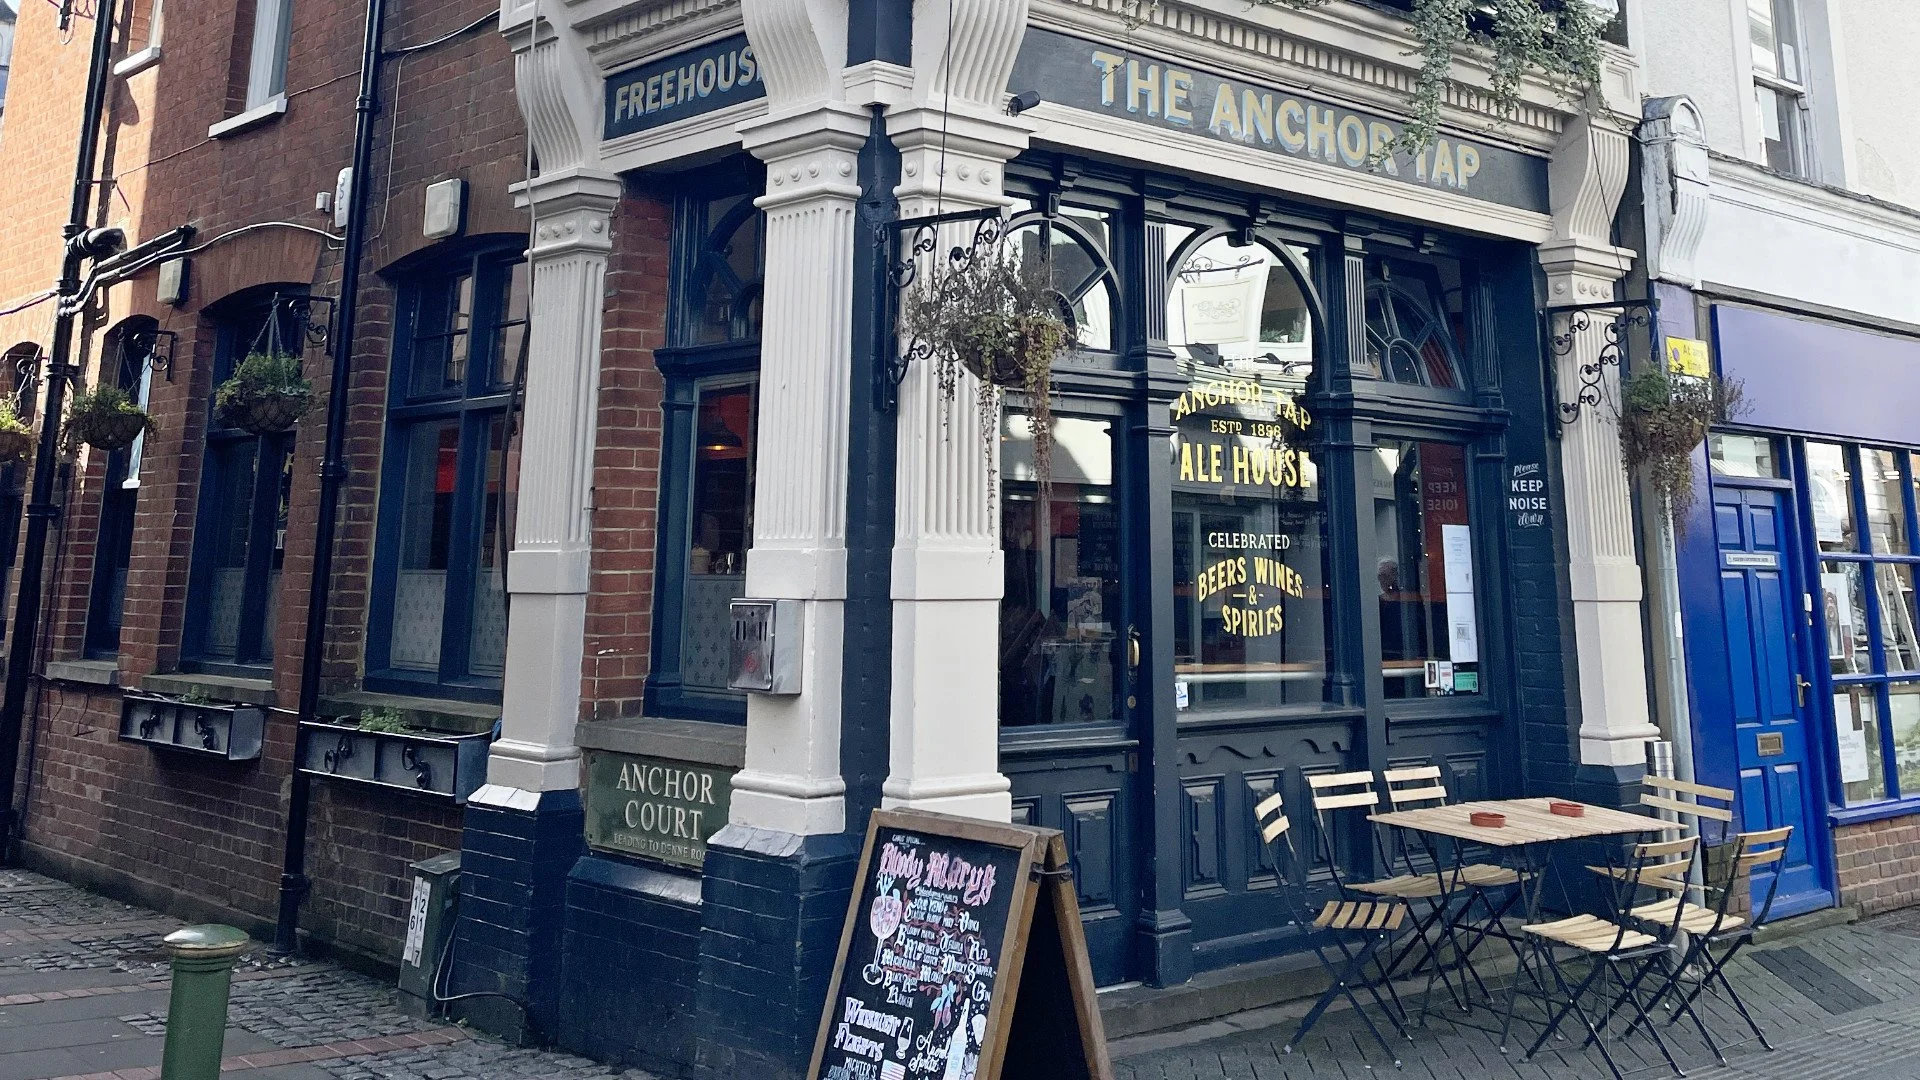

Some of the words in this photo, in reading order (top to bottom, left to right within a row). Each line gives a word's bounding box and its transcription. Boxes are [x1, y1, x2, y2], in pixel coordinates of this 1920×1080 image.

[1091, 50, 1194, 125] THE
[1208, 83, 1399, 175] ANCHOR
[1175, 380, 1263, 421] ANCHOR
[1272, 389, 1312, 431] TAP
[1179, 442, 1223, 482] ALE
[1232, 446, 1311, 488] HOUSE
[1513, 463, 1539, 477] Please
[1508, 497, 1547, 510] NOISE
[1511, 479, 1543, 492] KEEP
[1208, 532, 1290, 550] CELEBRATED
[1197, 556, 1247, 602] BEERS
[1254, 556, 1303, 599] WINES
[1222, 604, 1283, 637] SPIRITS
[616, 762, 715, 805] ANCHOR
[625, 800, 703, 841] COURT
[613, 833, 646, 850] LEADING
[648, 839, 659, 852] TO
